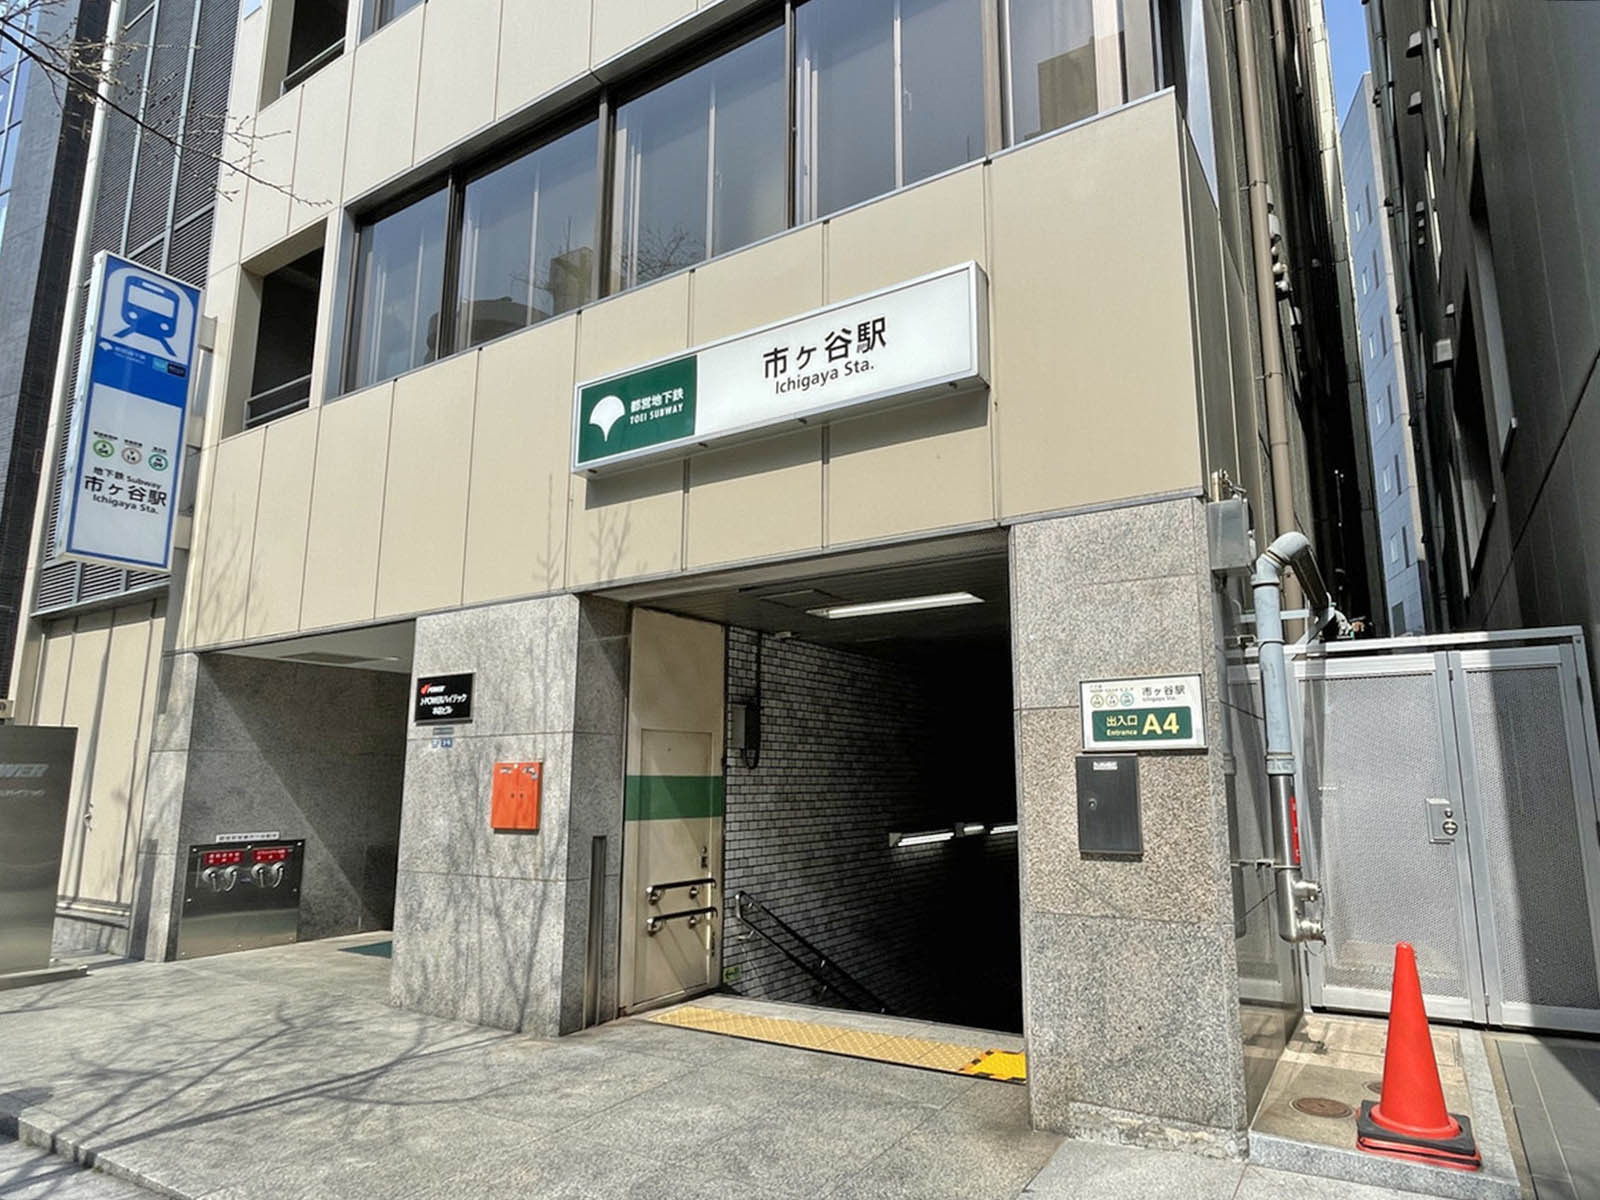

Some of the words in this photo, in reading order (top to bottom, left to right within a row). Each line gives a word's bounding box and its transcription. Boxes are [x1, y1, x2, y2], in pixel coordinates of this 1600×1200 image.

[763, 316, 887, 379] 市ヶ谷駅
[775, 368, 839, 395] Ichigaya
[844, 360, 874, 377] Sta.
[631, 387, 684, 413] 都営地下鉄
[650, 402, 684, 420] SUBWAY
[93, 466, 125, 480] 地下鉄
[126, 475, 162, 490] Subway
[84, 475, 167, 507] 市ヶ谷駅
[92, 494, 137, 511] Ichigaya
[139, 503, 160, 515] Sta.
[1105, 714, 1138, 727] 出入口
[1142, 711, 1180, 736] A4
[1105, 729, 1138, 737] Entrance
